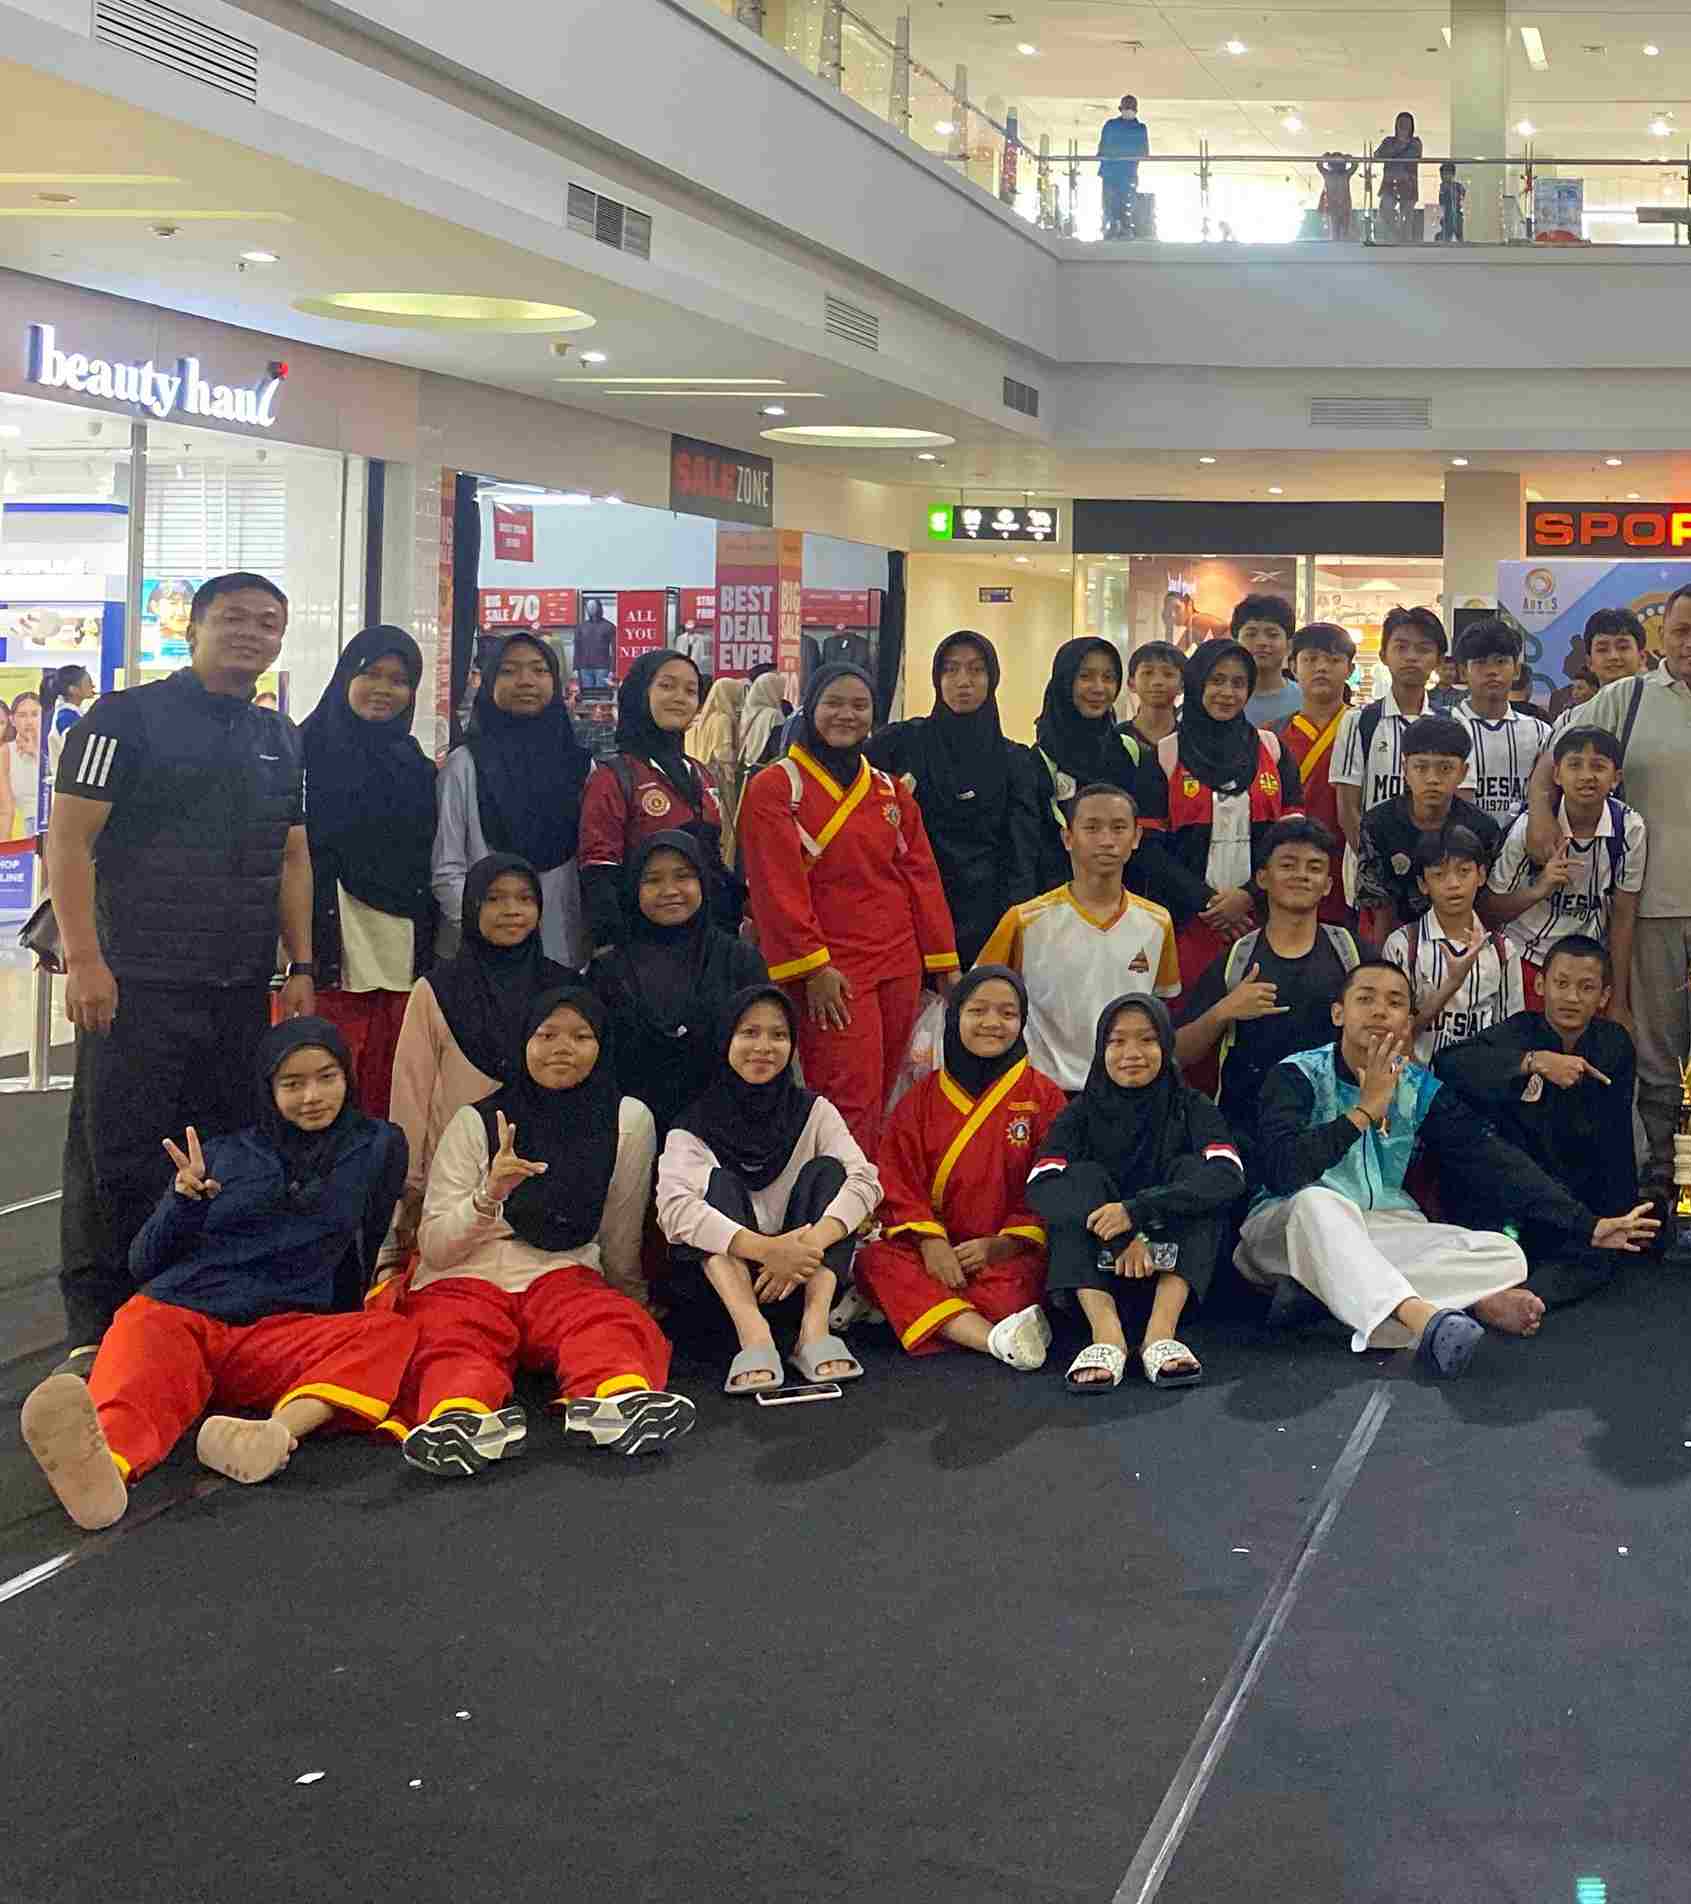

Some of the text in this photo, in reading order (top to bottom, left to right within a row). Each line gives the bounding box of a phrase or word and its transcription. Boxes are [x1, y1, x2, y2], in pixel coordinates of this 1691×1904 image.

[32, 323, 288, 427] beauty haul
[736, 465, 769, 508] ZONE
[508, 594, 540, 621] 70
[719, 585, 773, 612] BEST
[626, 610, 656, 622] ALL
[719, 615, 773, 641] DEAL
[624, 628, 657, 641] YOU
[719, 643, 773, 670] EVER
[0, 859, 20, 870] HOP
[0, 873, 24, 883] LINE
